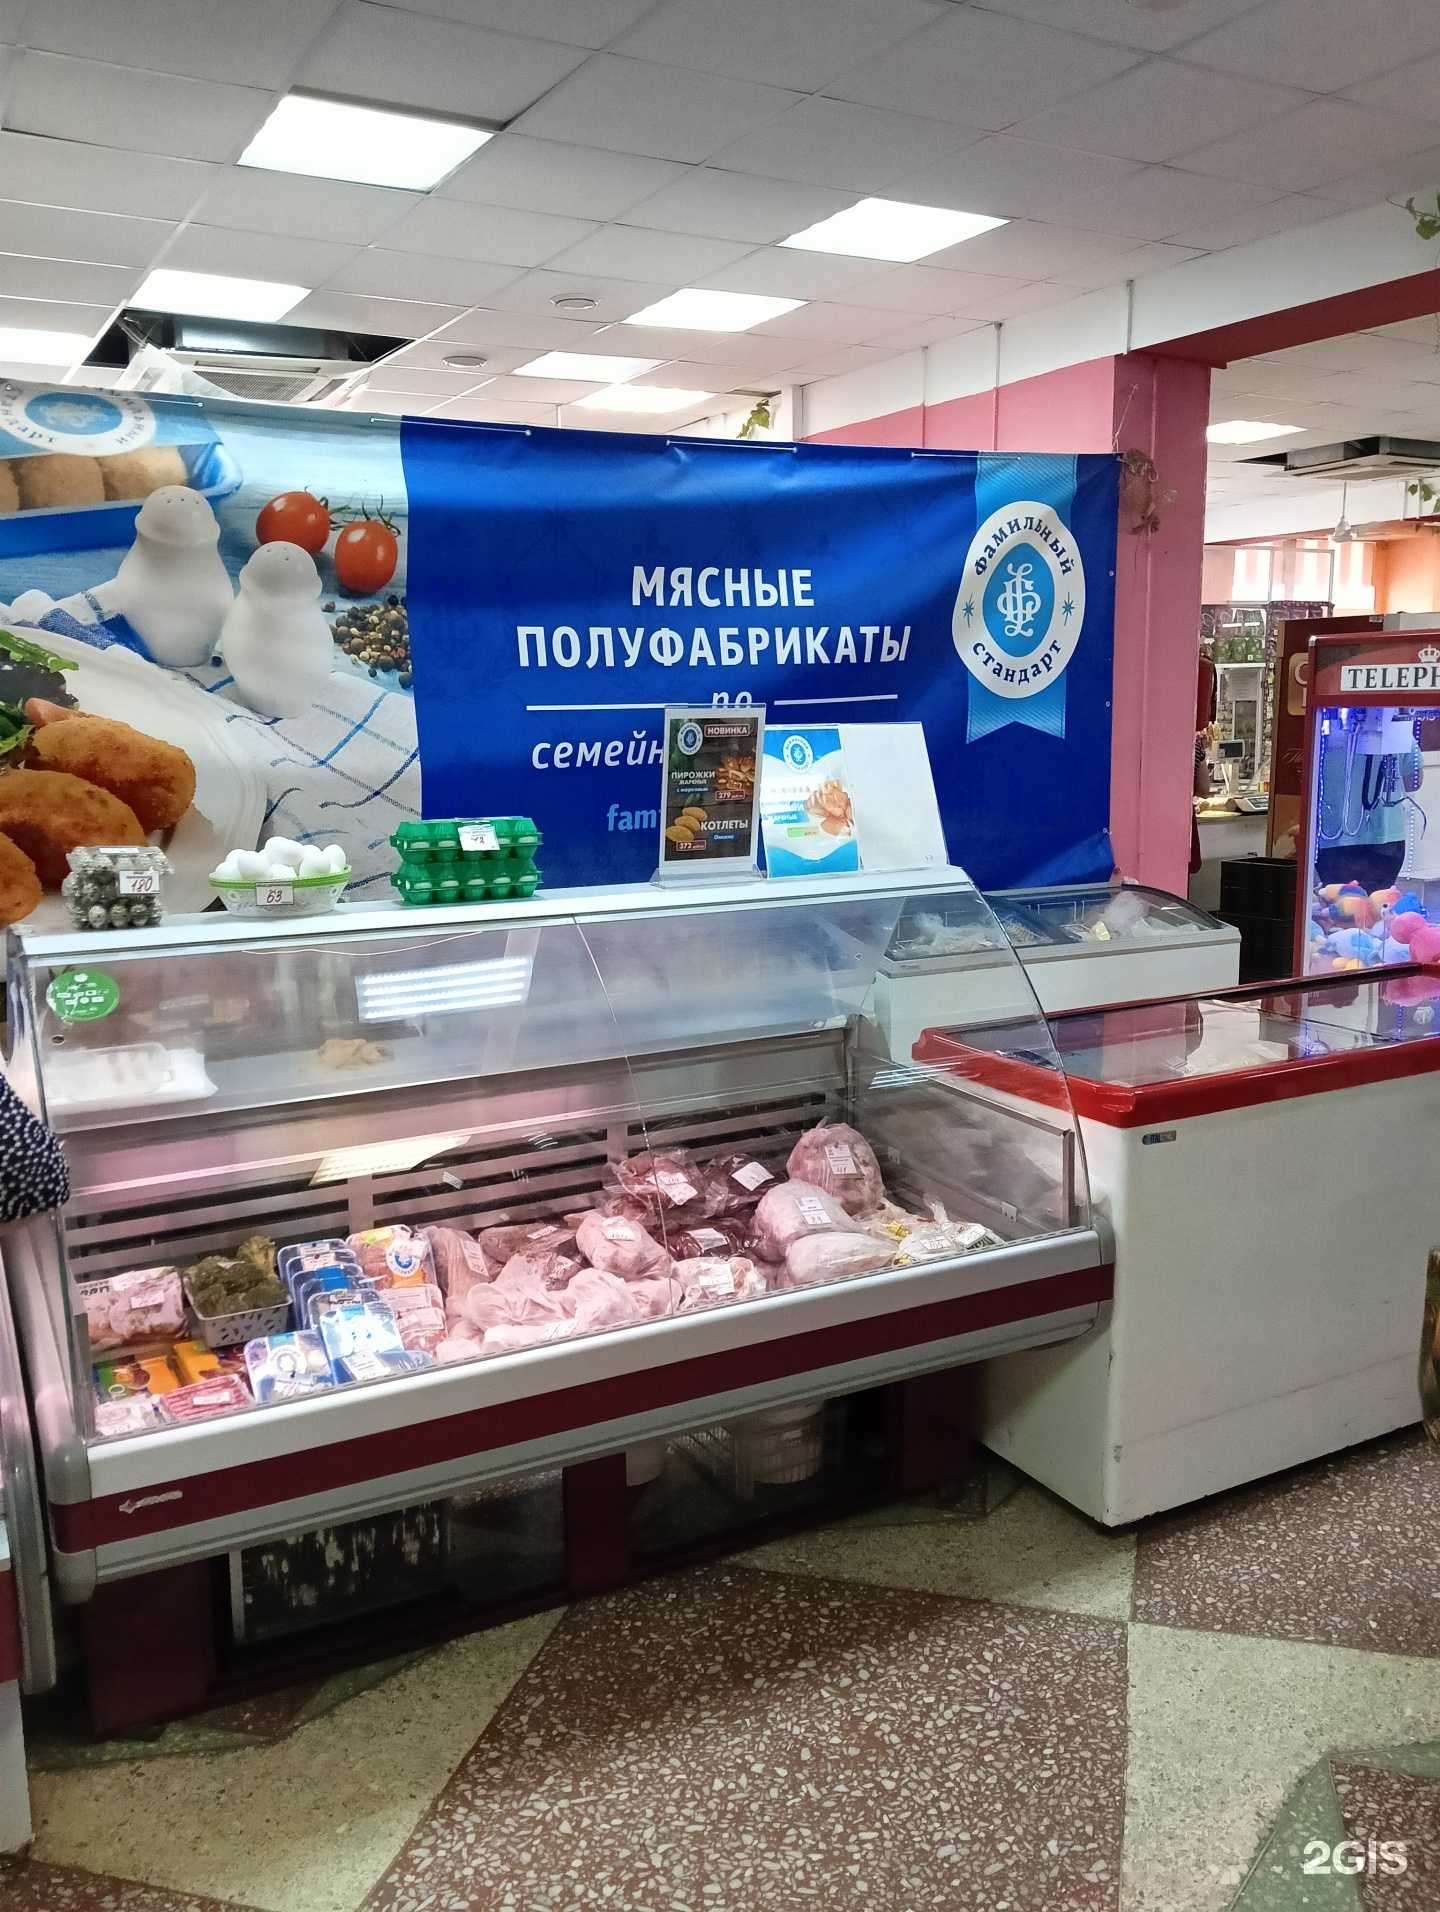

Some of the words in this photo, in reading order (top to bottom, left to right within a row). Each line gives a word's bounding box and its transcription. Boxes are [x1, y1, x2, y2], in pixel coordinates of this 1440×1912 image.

[975, 516, 1075, 576] Фамильный
[631, 566, 814, 607] МЯСНЫЕ
[516, 625, 911, 668] ПОЛУФАБРИКАТЫ
[972, 639, 1063, 686] стандарт
[532, 730, 664, 769] семейн
[707, 726, 748, 735] НОВИНКА
[671, 771, 715, 779] ПИРОЖКИ
[607, 803, 662, 831] fam
[701, 819, 748, 831] КОТЛЕТЫ
